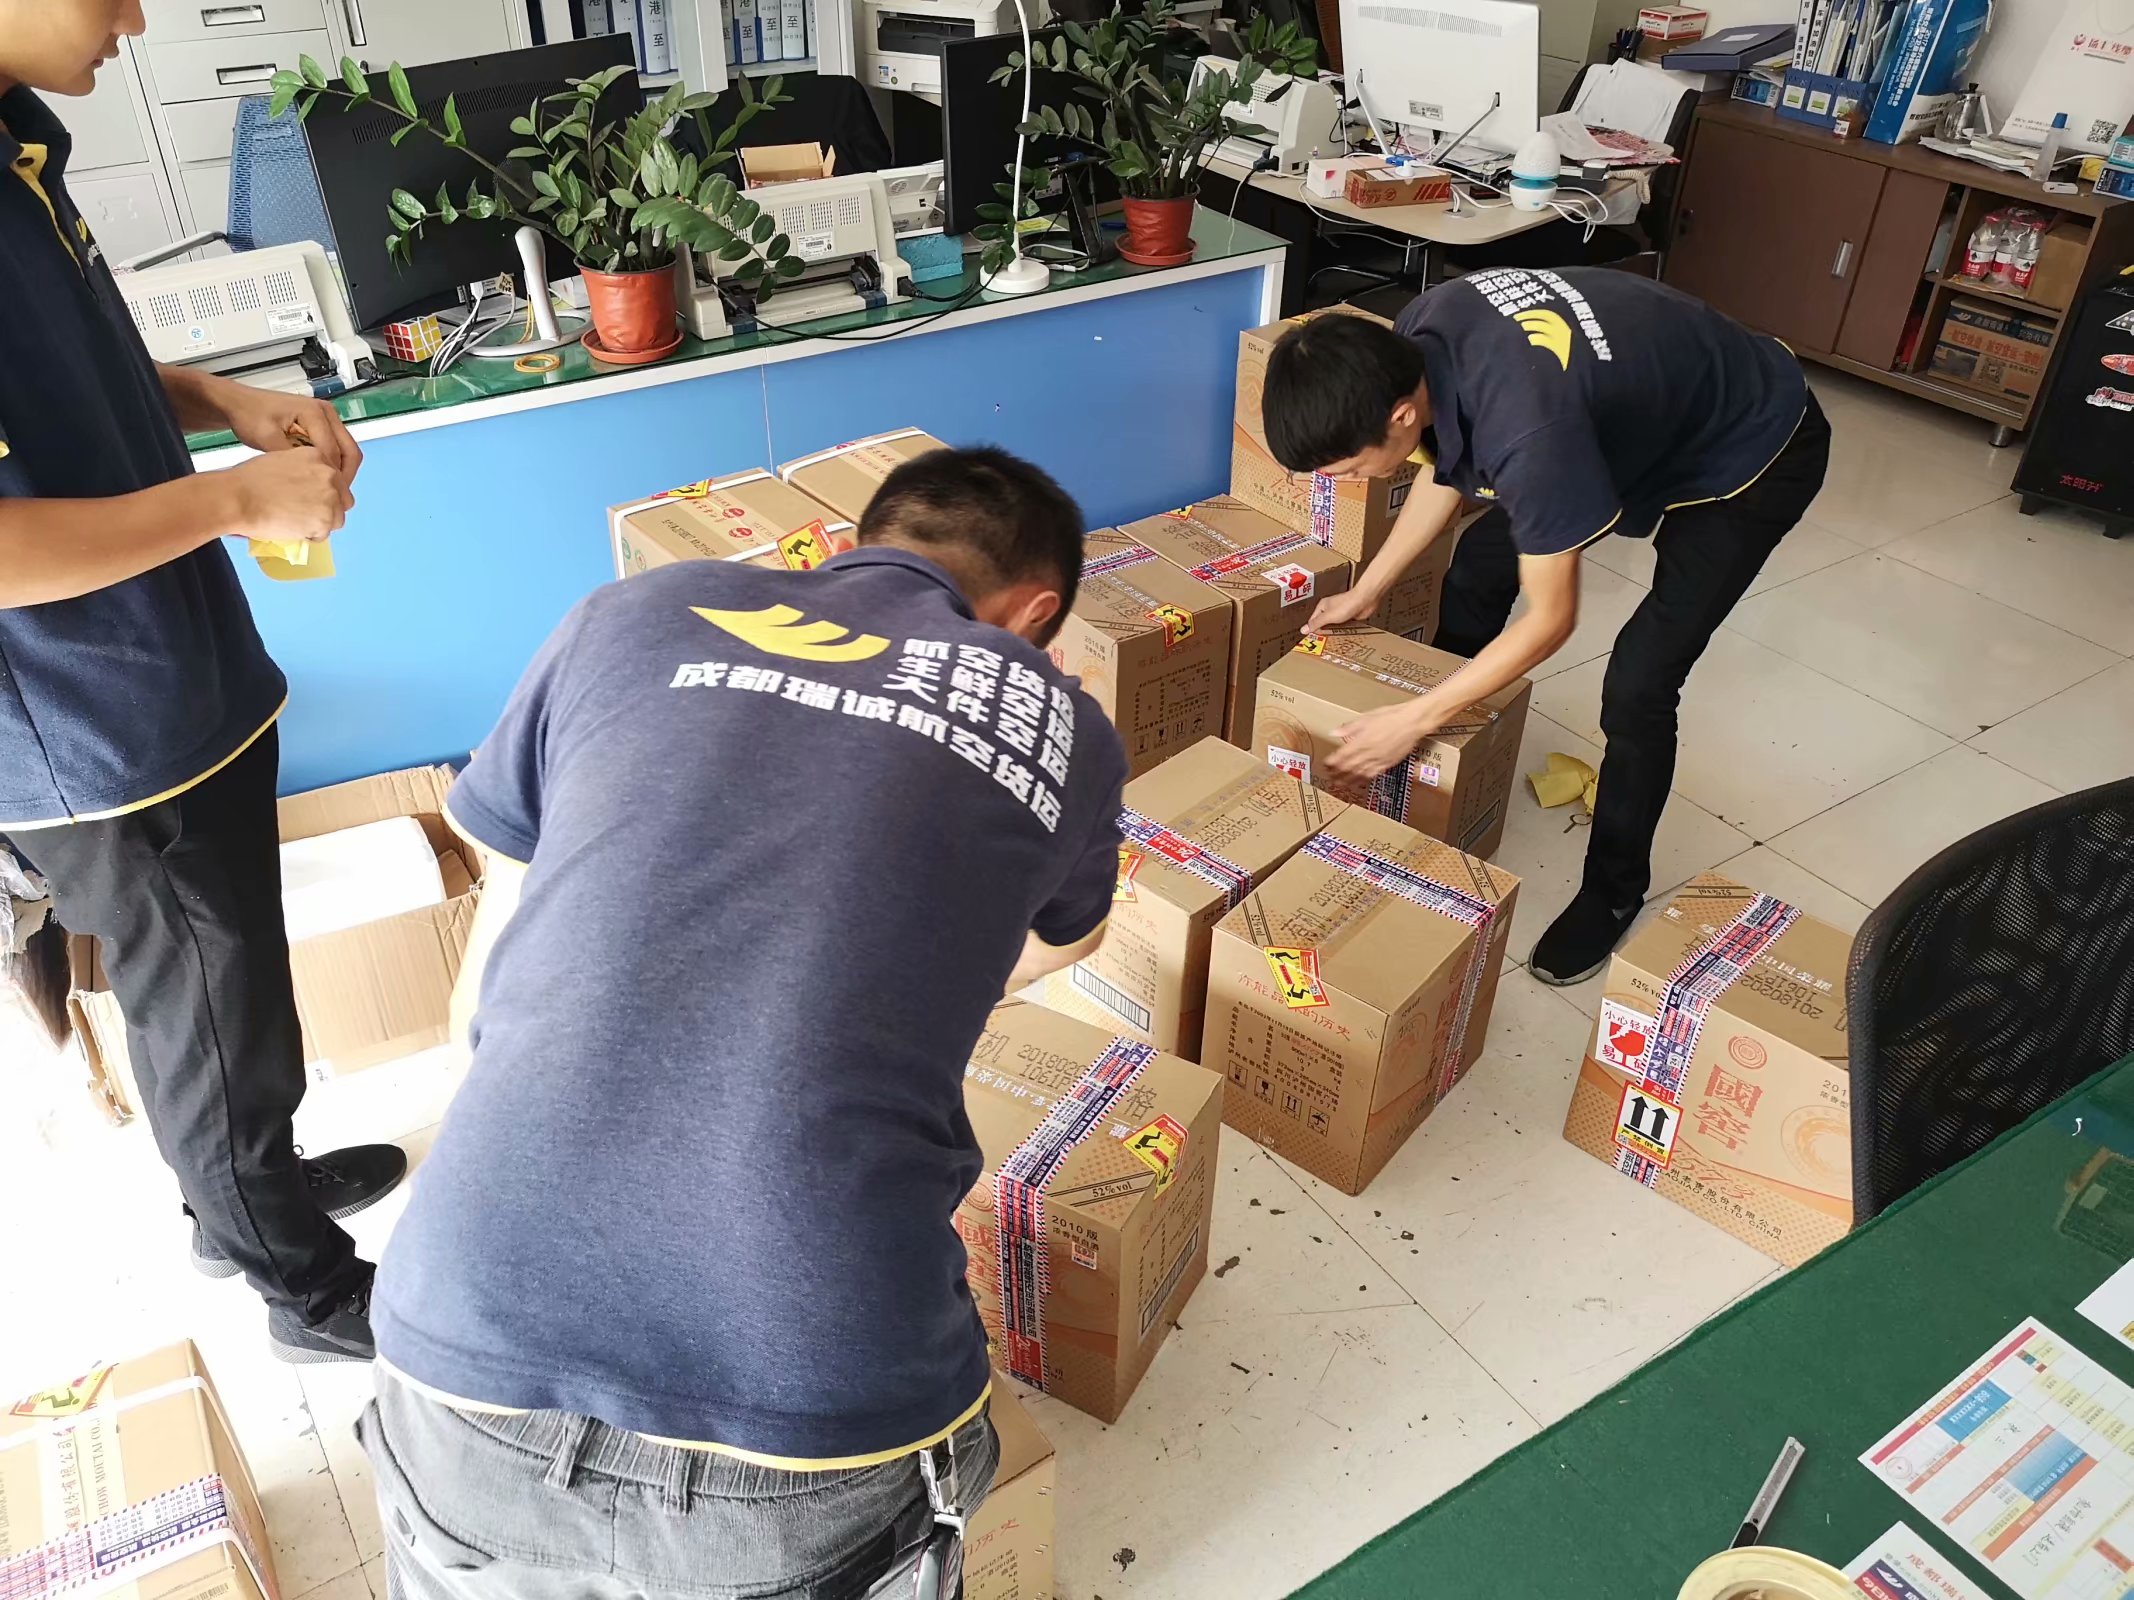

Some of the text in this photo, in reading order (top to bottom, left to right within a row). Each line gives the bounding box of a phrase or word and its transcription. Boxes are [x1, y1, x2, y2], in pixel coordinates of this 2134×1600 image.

[669, 660, 1063, 833] 成都瑞诚航空货运
[1237, 971, 1352, 1042] 你能品的历史
